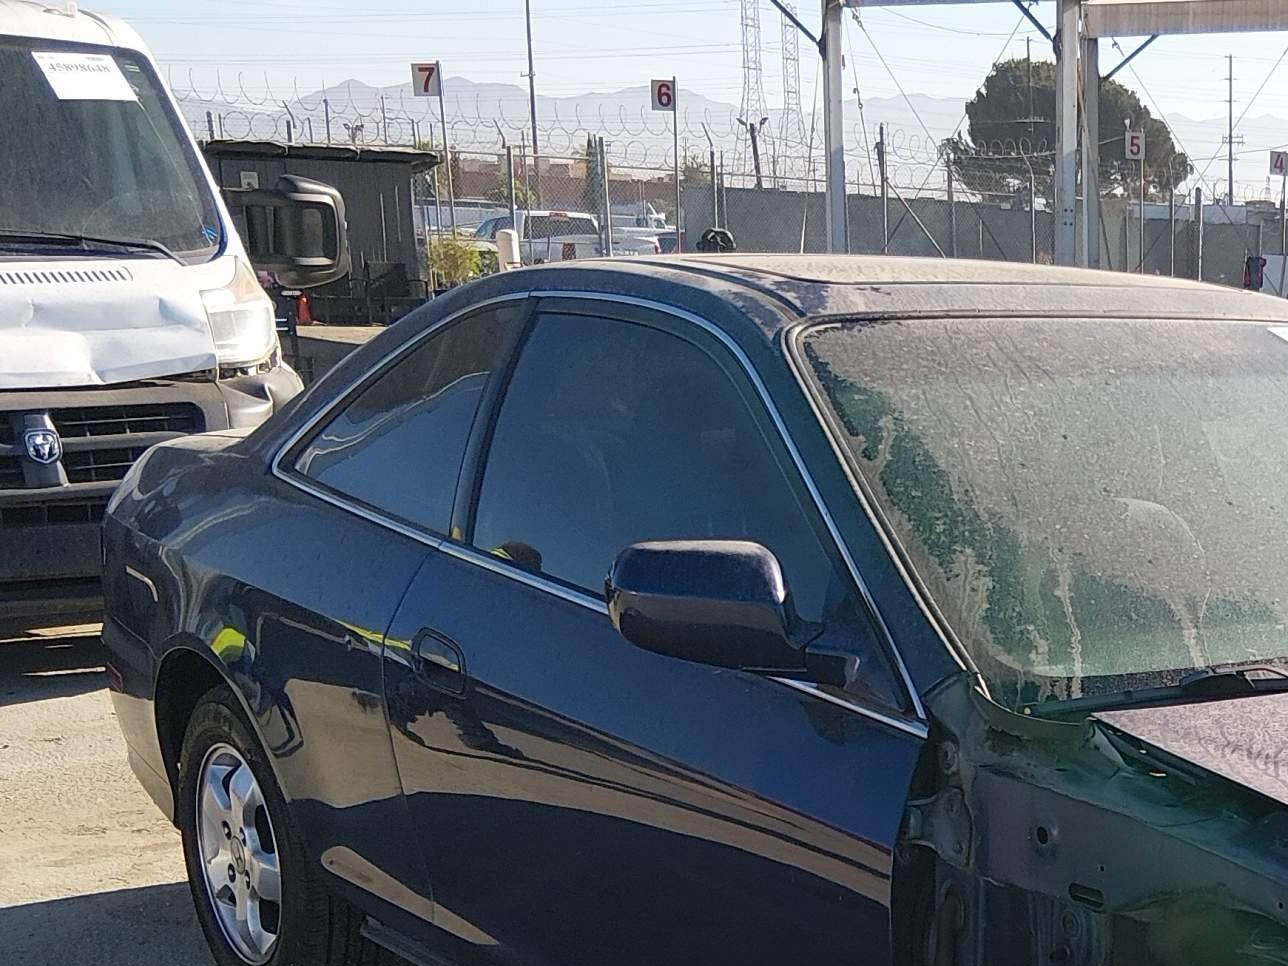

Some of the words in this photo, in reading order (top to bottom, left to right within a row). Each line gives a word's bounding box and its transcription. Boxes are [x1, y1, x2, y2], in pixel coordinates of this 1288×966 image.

[417, 66, 435, 93] 7
[657, 83, 672, 108] 6
[1130, 136, 1141, 156] 5
[1273, 154, 1284, 173] 4
